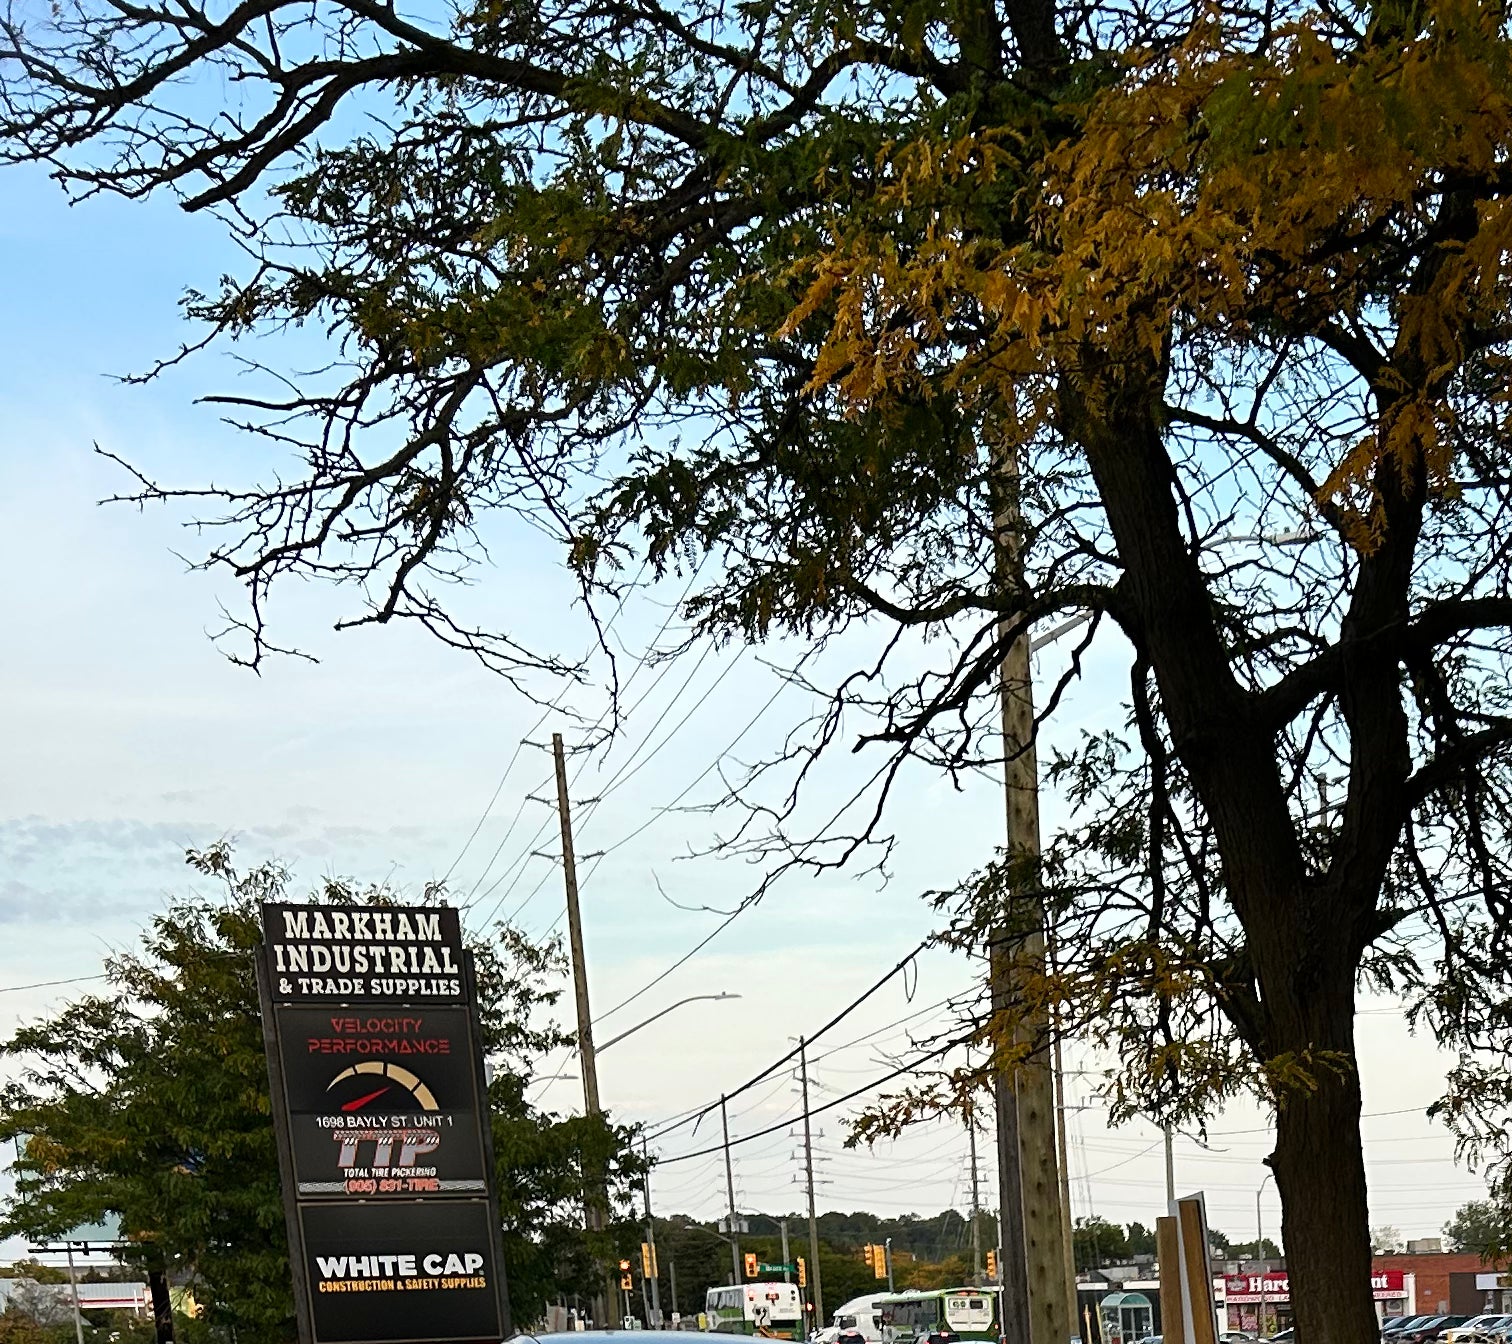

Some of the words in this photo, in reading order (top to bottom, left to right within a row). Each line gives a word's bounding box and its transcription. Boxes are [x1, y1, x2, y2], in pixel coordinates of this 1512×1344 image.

[282, 911, 442, 941] MARKHAM
[274, 944, 459, 974] INDUSTRIAL
[279, 978, 293, 994] &
[298, 978, 365, 995] TRADE
[370, 979, 461, 996] SUPPLIES
[330, 1018, 422, 1033] VELOCITY
[307, 1038, 450, 1054] PERFORMANCE
[316, 1116, 344, 1128] 1698
[347, 1116, 387, 1128] BAYLY
[414, 1116, 443, 1127] UNIT
[447, 1115, 453, 1127] 1
[333, 1128, 440, 1168] TTP
[344, 1167, 369, 1177] TOTAL
[316, 1254, 418, 1279] WHITE
[319, 1279, 395, 1293] CONSTRUCTION
[405, 1278, 439, 1291] SAFETY
[441, 1277, 486, 1290] SUPPLIES
